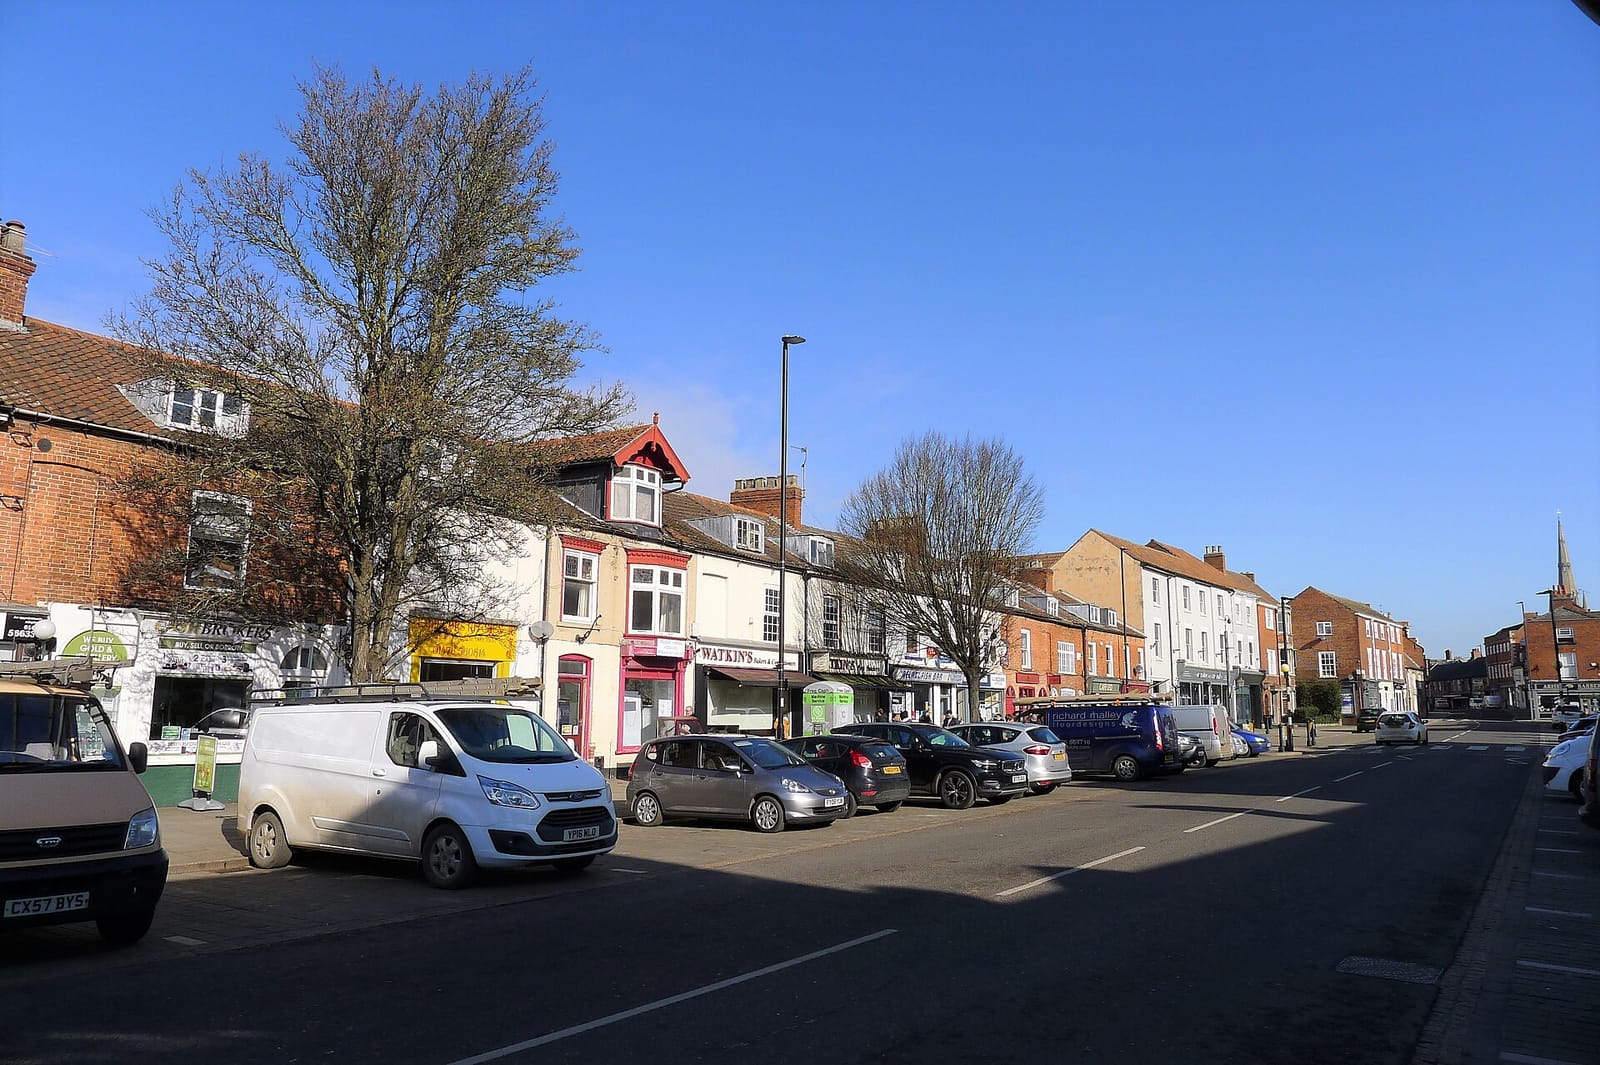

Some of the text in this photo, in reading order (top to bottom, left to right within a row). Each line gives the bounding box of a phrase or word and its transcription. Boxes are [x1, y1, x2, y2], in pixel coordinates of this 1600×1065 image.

[80, 645, 105, 653] GOLD
[190, 642, 203, 650] SELL
[701, 647, 753, 664] WATKIN'S
[1052, 711, 1122, 720] richard malley
[11, 895, 84, 915] CX57 BYS
